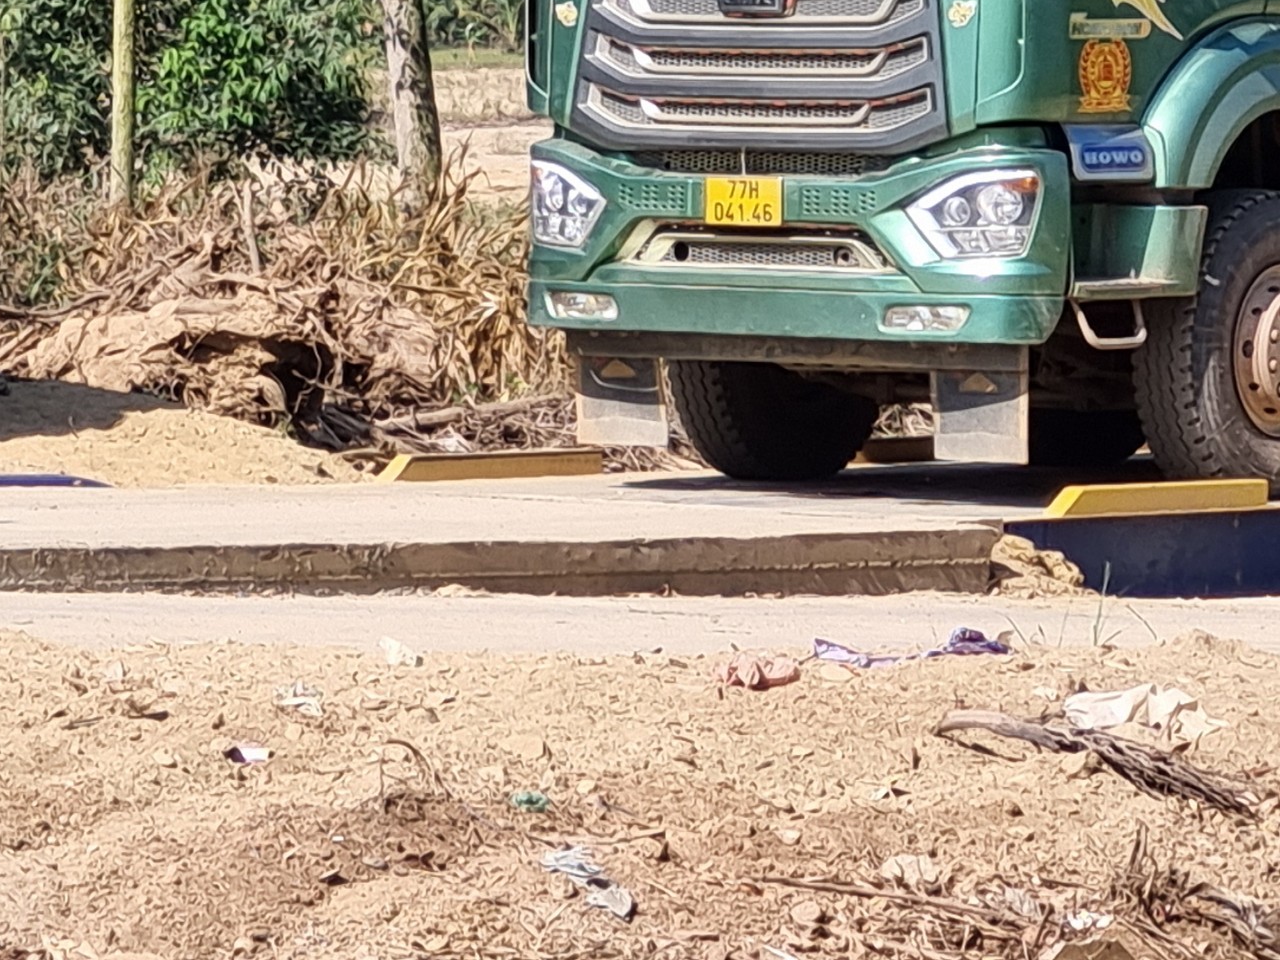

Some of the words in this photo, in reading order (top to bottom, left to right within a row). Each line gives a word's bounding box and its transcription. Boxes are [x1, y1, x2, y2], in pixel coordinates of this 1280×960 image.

[1083, 150, 1143, 165] HOWO
[728, 179, 759, 199] 77H
[714, 202, 773, 223] 041.46
